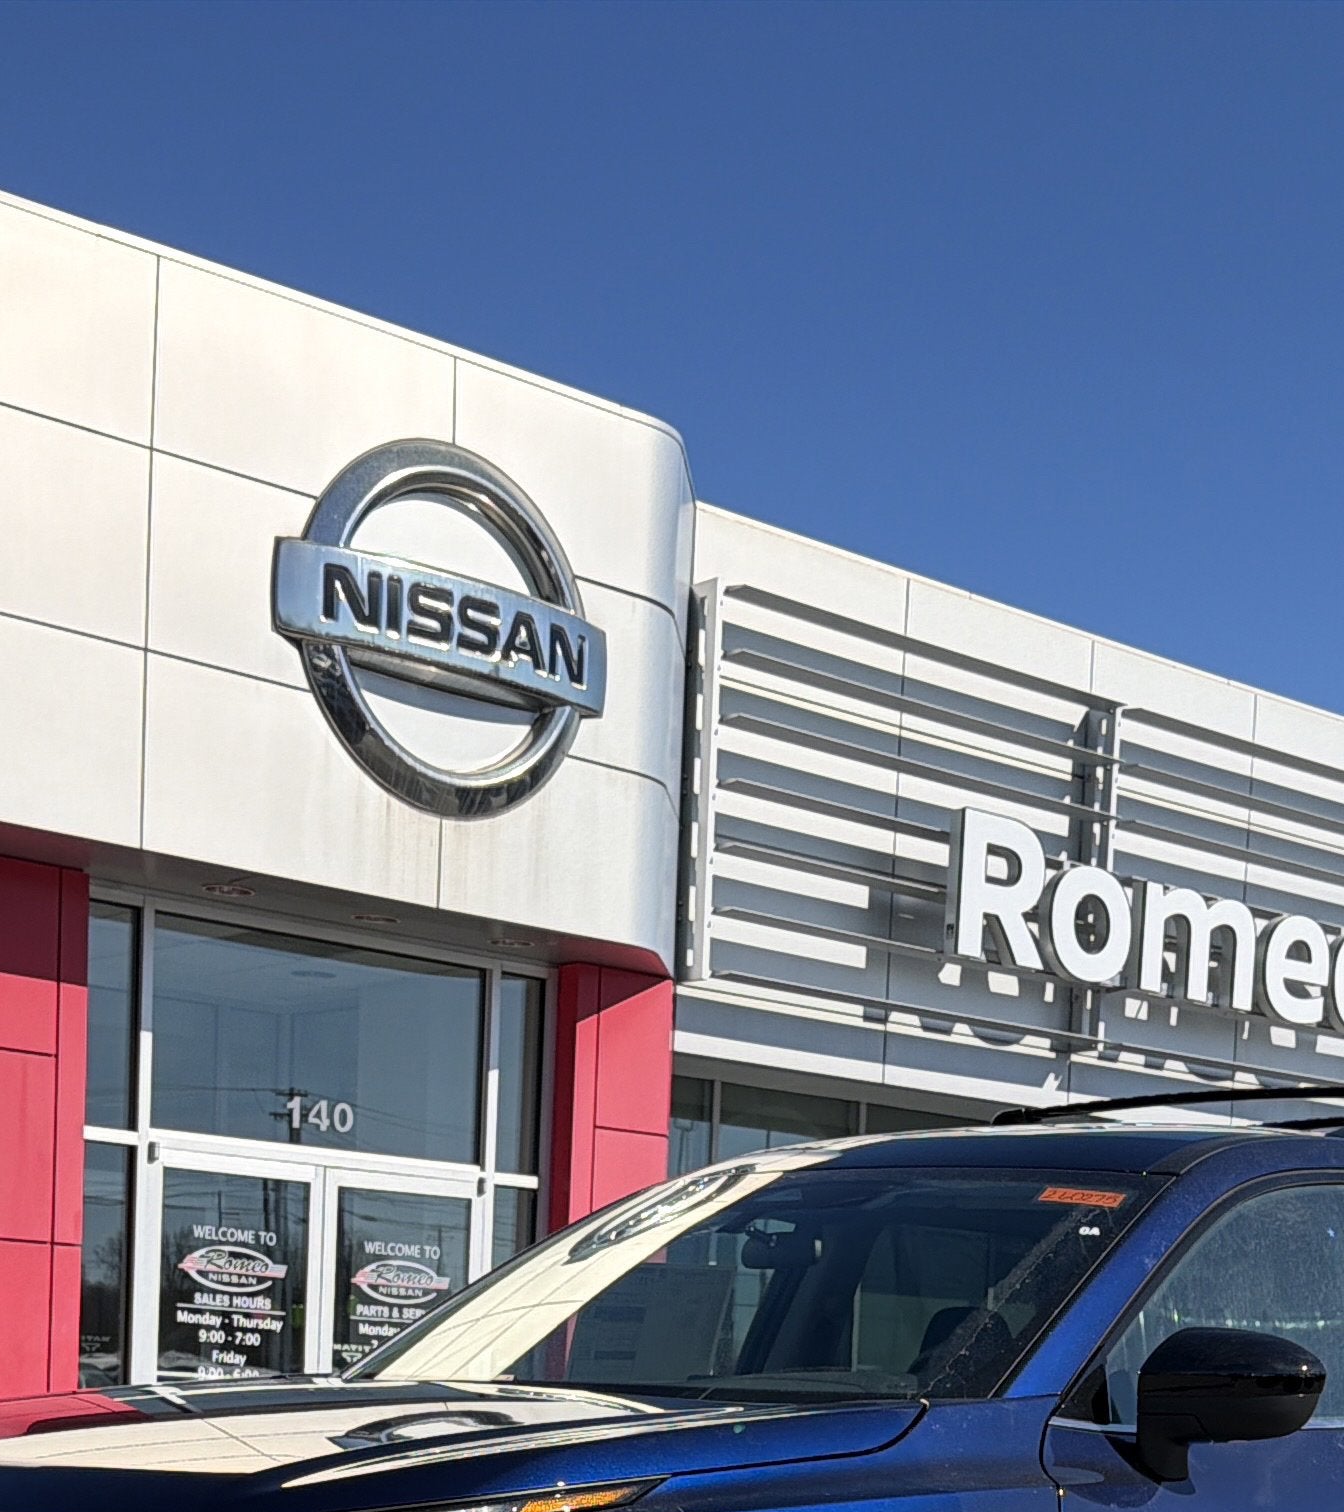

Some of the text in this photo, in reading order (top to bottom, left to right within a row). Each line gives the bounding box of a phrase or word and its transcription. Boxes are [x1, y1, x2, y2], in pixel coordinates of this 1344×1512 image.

[320, 562, 587, 690] NISSAN
[286, 1096, 354, 1133] 140
[192, 1224, 277, 1246] WELCOME TO
[363, 1240, 441, 1260] WELCOME TO
[199, 1249, 270, 1274] Romeo
[208, 1272, 257, 1285] NISSAN
[374, 1264, 434, 1286] Romeo
[193, 1292, 272, 1310] SALES HOURS
[378, 1286, 423, 1297] NISSAN
[356, 1304, 390, 1318] PARTS
[392, 1307, 400, 1318] &
[176, 1310, 223, 1329] Monday
[231, 1314, 284, 1333] Thursday
[198, 1329, 225, 1343] 9:00
[234, 1332, 261, 1347] 7:00
[212, 1350, 247, 1367] Friday
